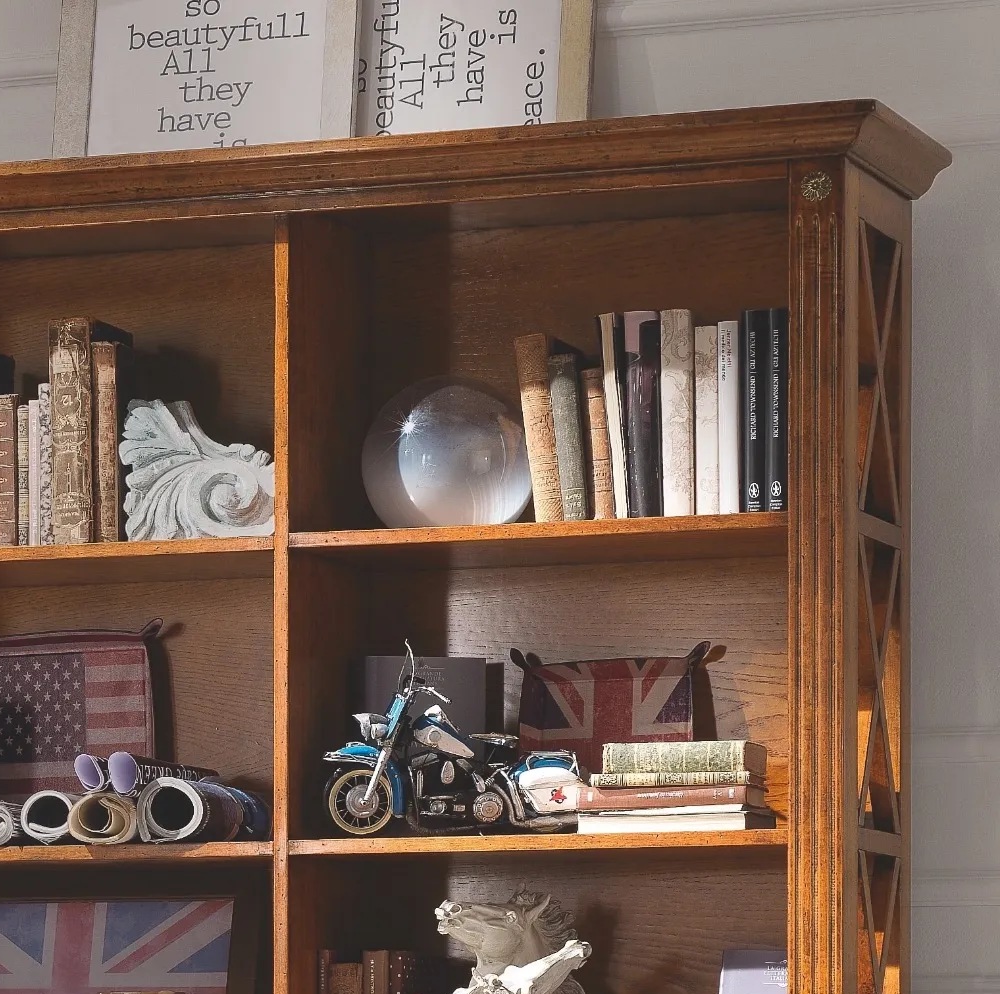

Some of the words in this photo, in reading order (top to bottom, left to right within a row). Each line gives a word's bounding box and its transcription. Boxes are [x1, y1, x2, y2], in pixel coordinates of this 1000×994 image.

[185, 0, 221, 18] so
[489, 8, 518, 45] is
[128, 12, 310, 51] beautyfull
[429, 13, 465, 89] they
[159, 48, 216, 76] All
[374, 0, 405, 136] eautyfu
[398, 53, 426, 110] All
[456, 28, 487, 107] have
[178, 78, 253, 107] they
[523, 48, 546, 126] eace.
[157, 106, 232, 133] have
